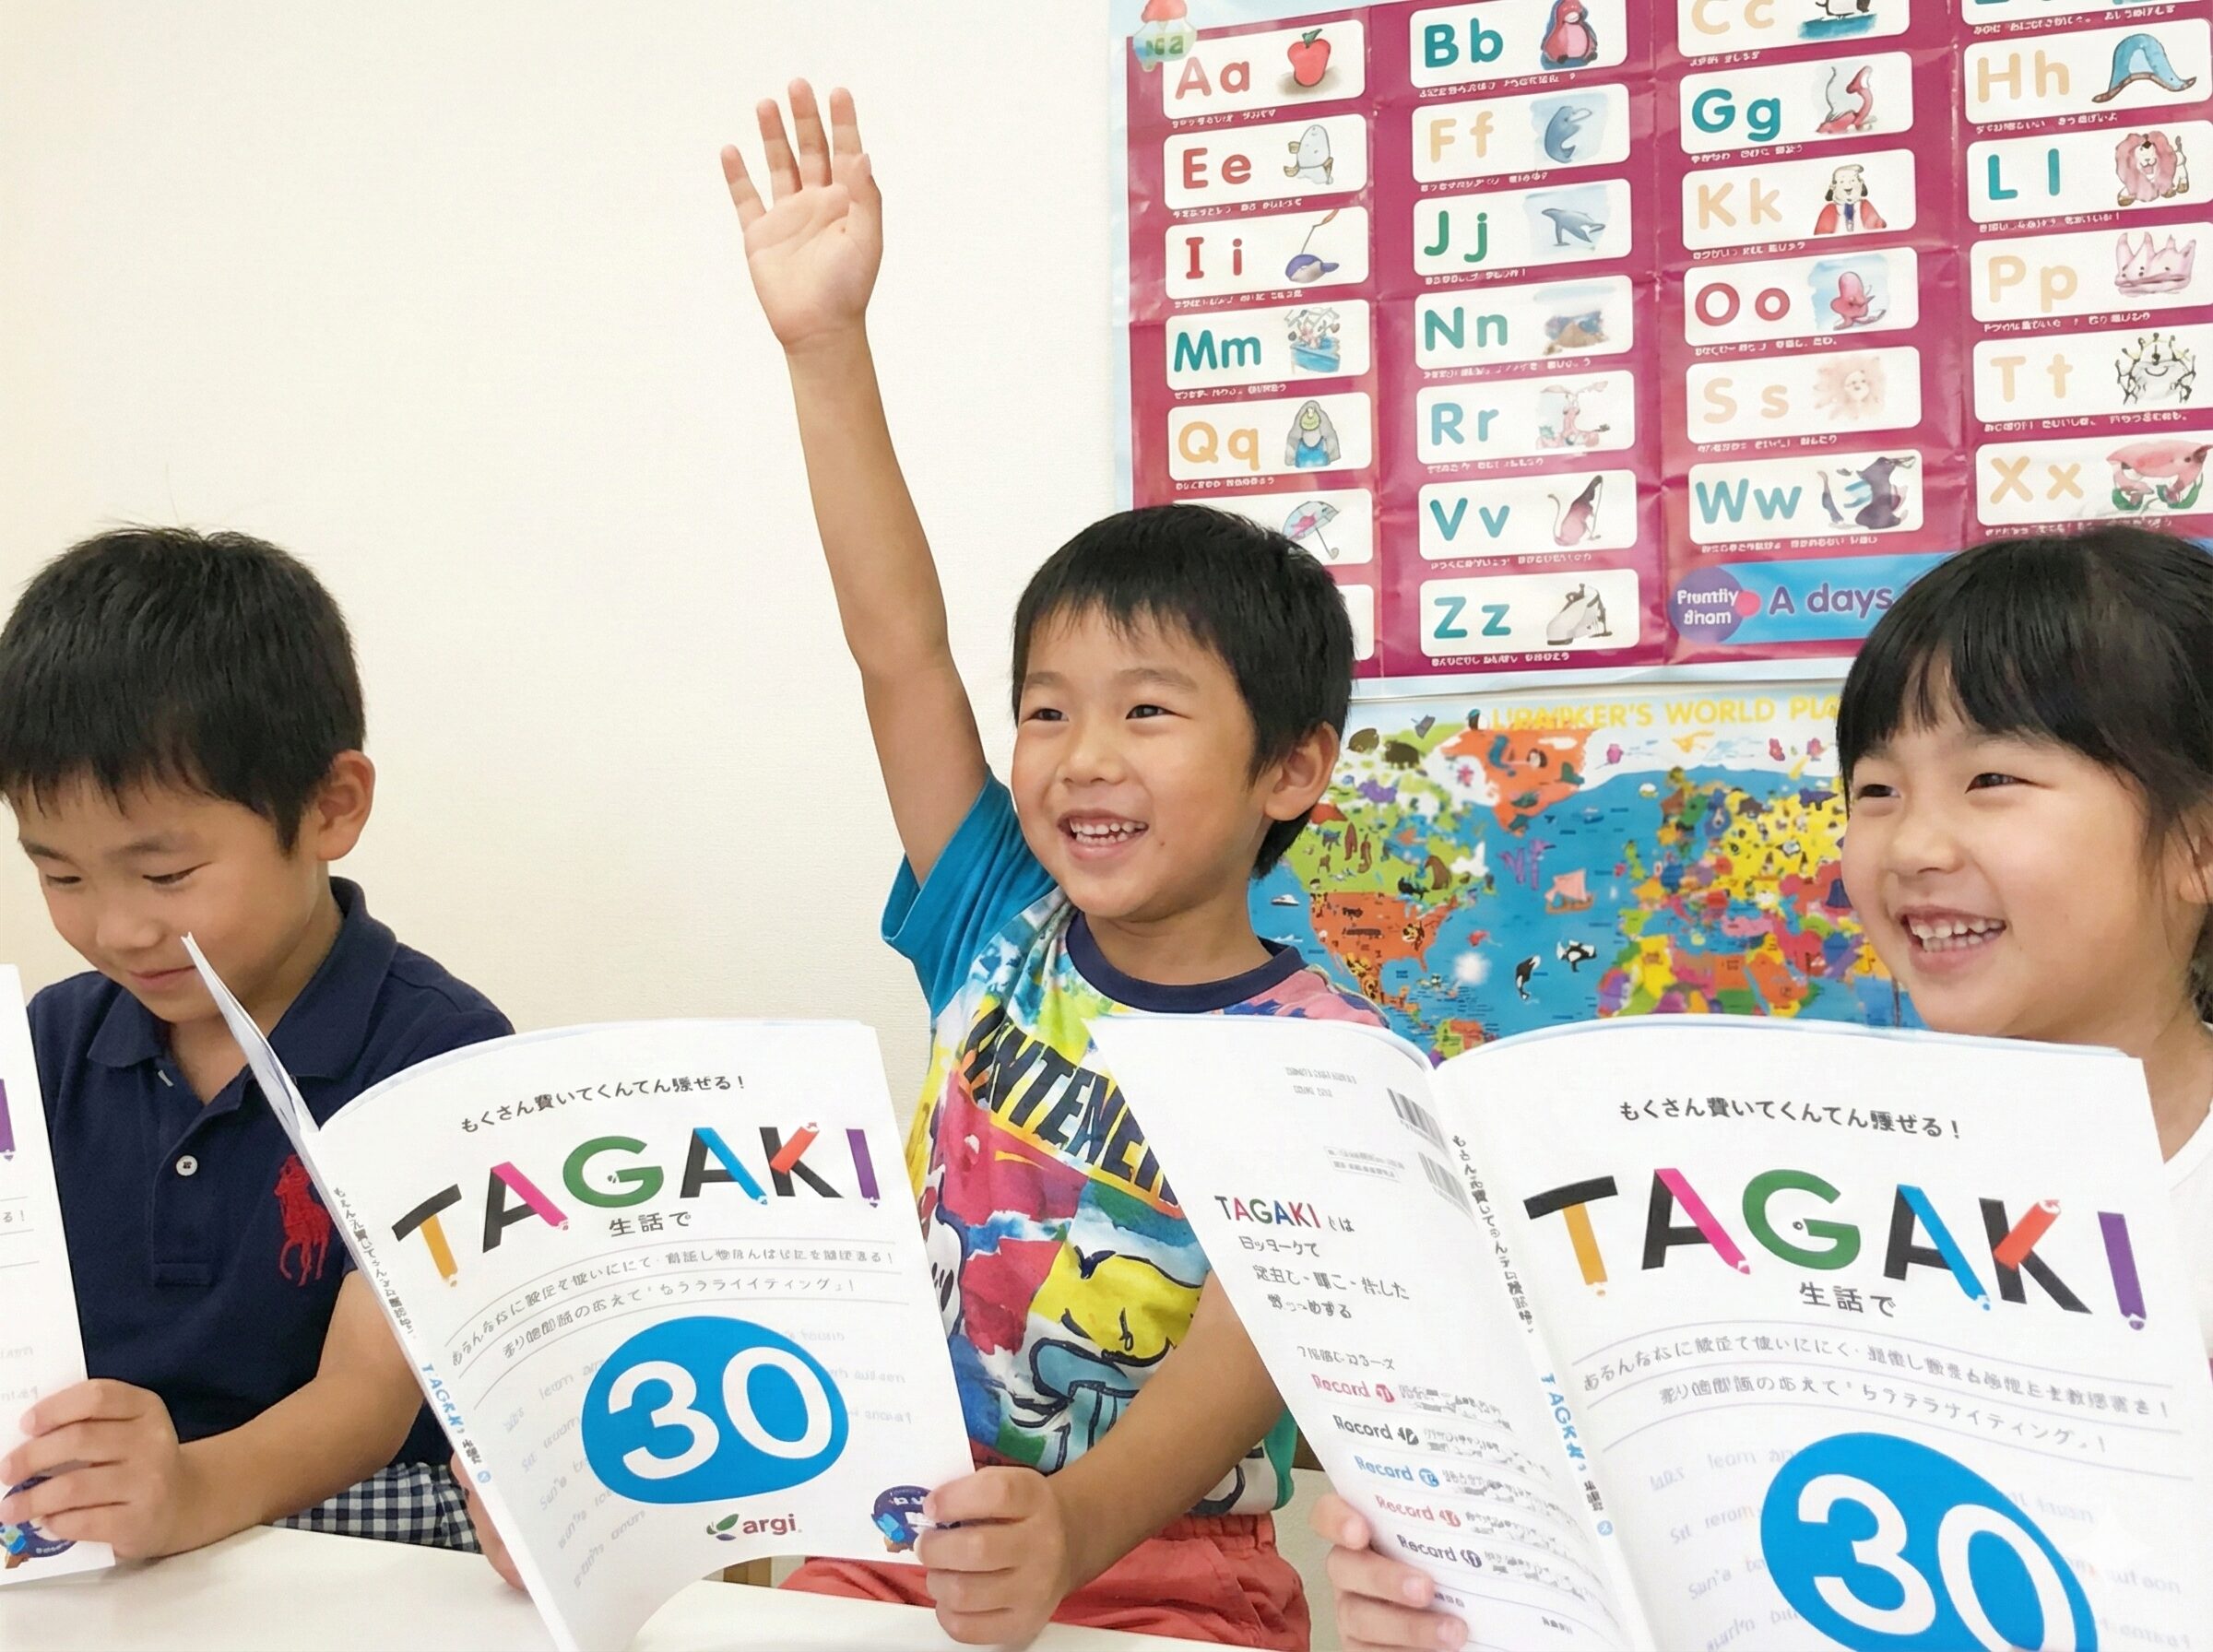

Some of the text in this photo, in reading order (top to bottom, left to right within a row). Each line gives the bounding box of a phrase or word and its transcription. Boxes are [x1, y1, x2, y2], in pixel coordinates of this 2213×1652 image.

[1769, 583, 1893, 619] A days
[1665, 698, 1775, 725] WORLD
[391, 1122, 881, 1288] TAGAKI
[1214, 1196, 1322, 1229] TAGAKI
[1524, 1167, 2148, 1330] TAGAKI
[608, 1346, 832, 1480] 30
[742, 1514, 797, 1536] argi
[1798, 1474, 2077, 1652] 30
